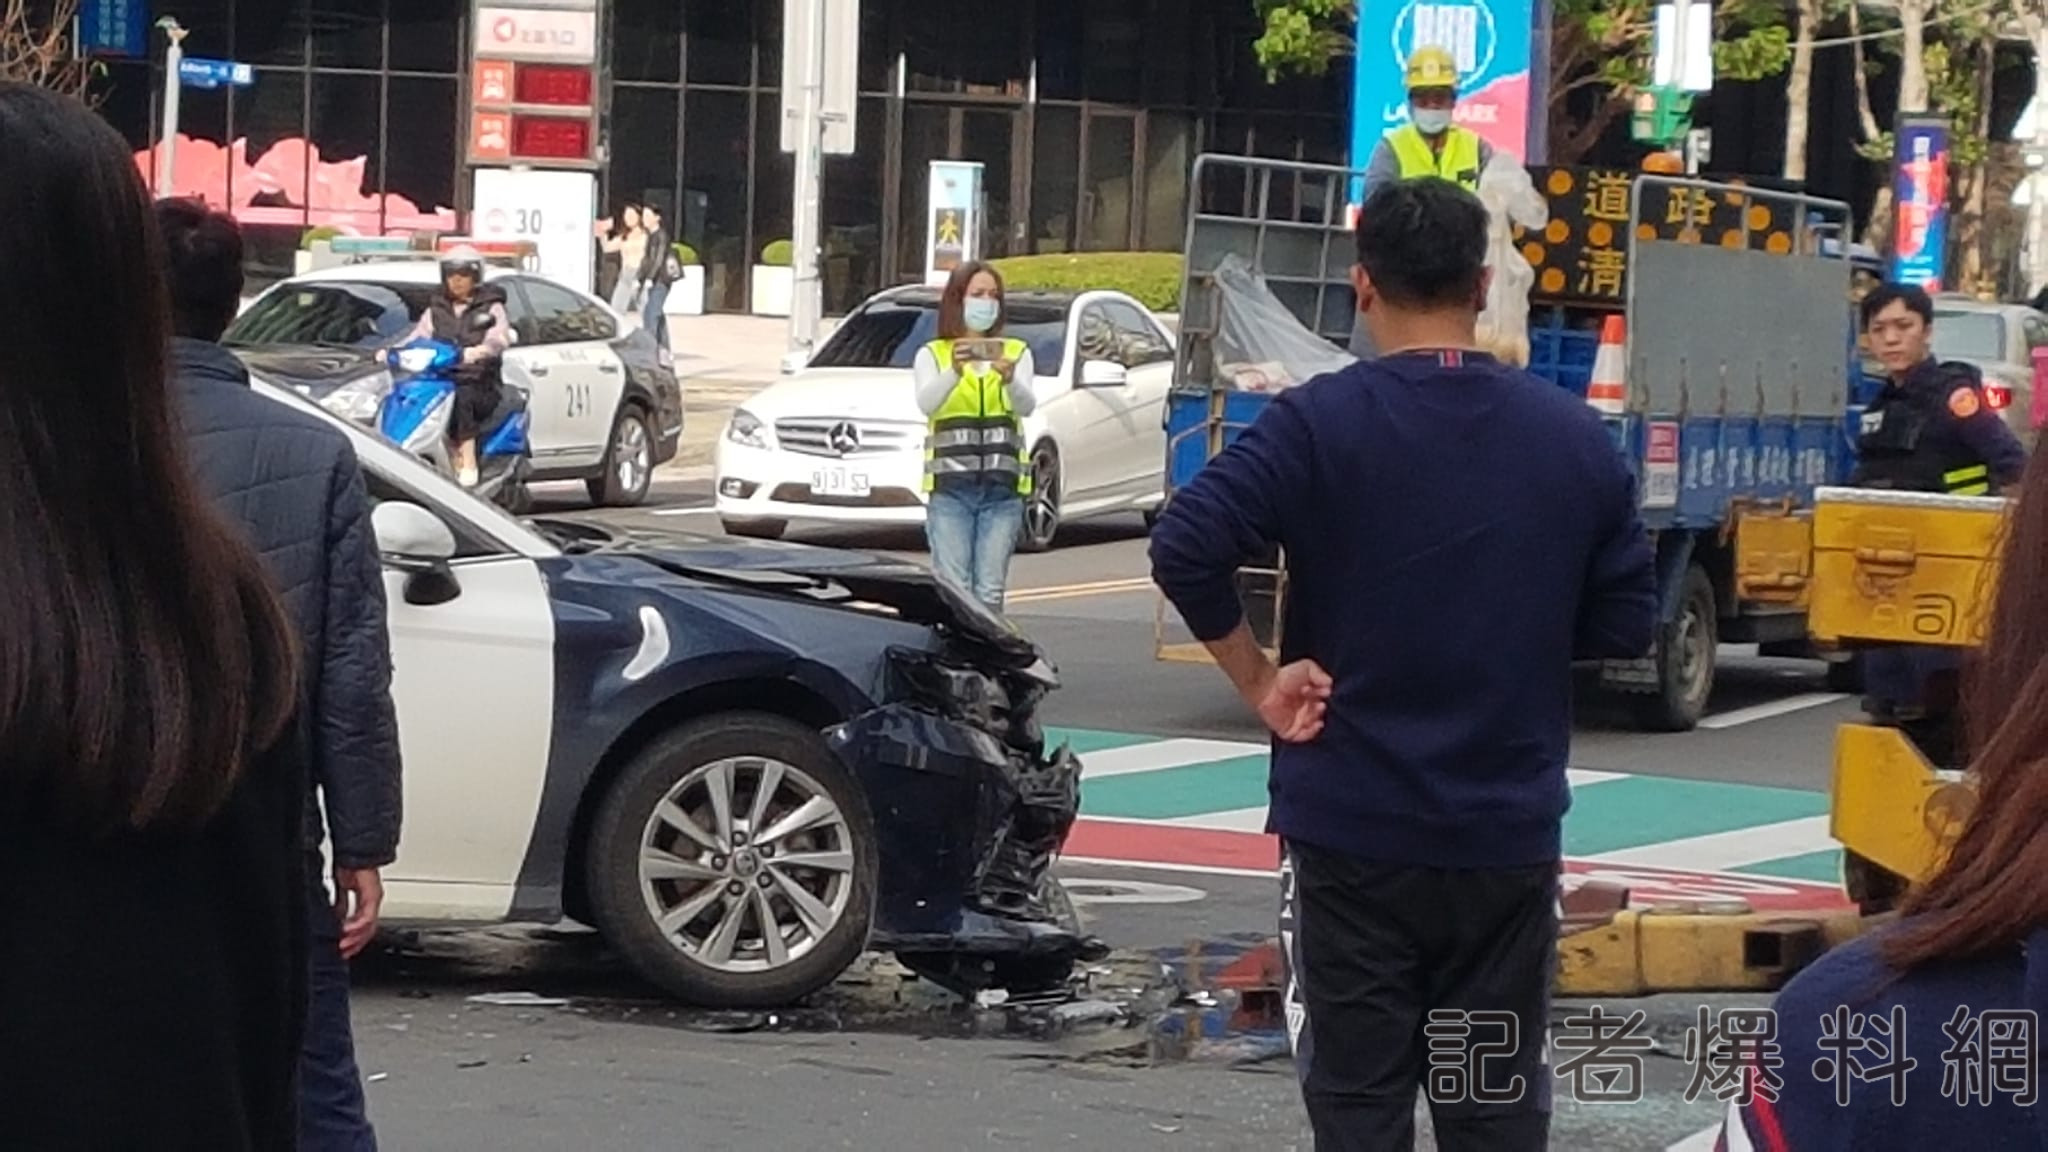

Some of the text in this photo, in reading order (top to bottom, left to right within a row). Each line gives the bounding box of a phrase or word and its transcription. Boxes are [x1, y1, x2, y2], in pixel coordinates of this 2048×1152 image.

[1383, 102, 1498, 123] LAARK
[515, 208, 542, 234] 30
[566, 383, 592, 418] 241
